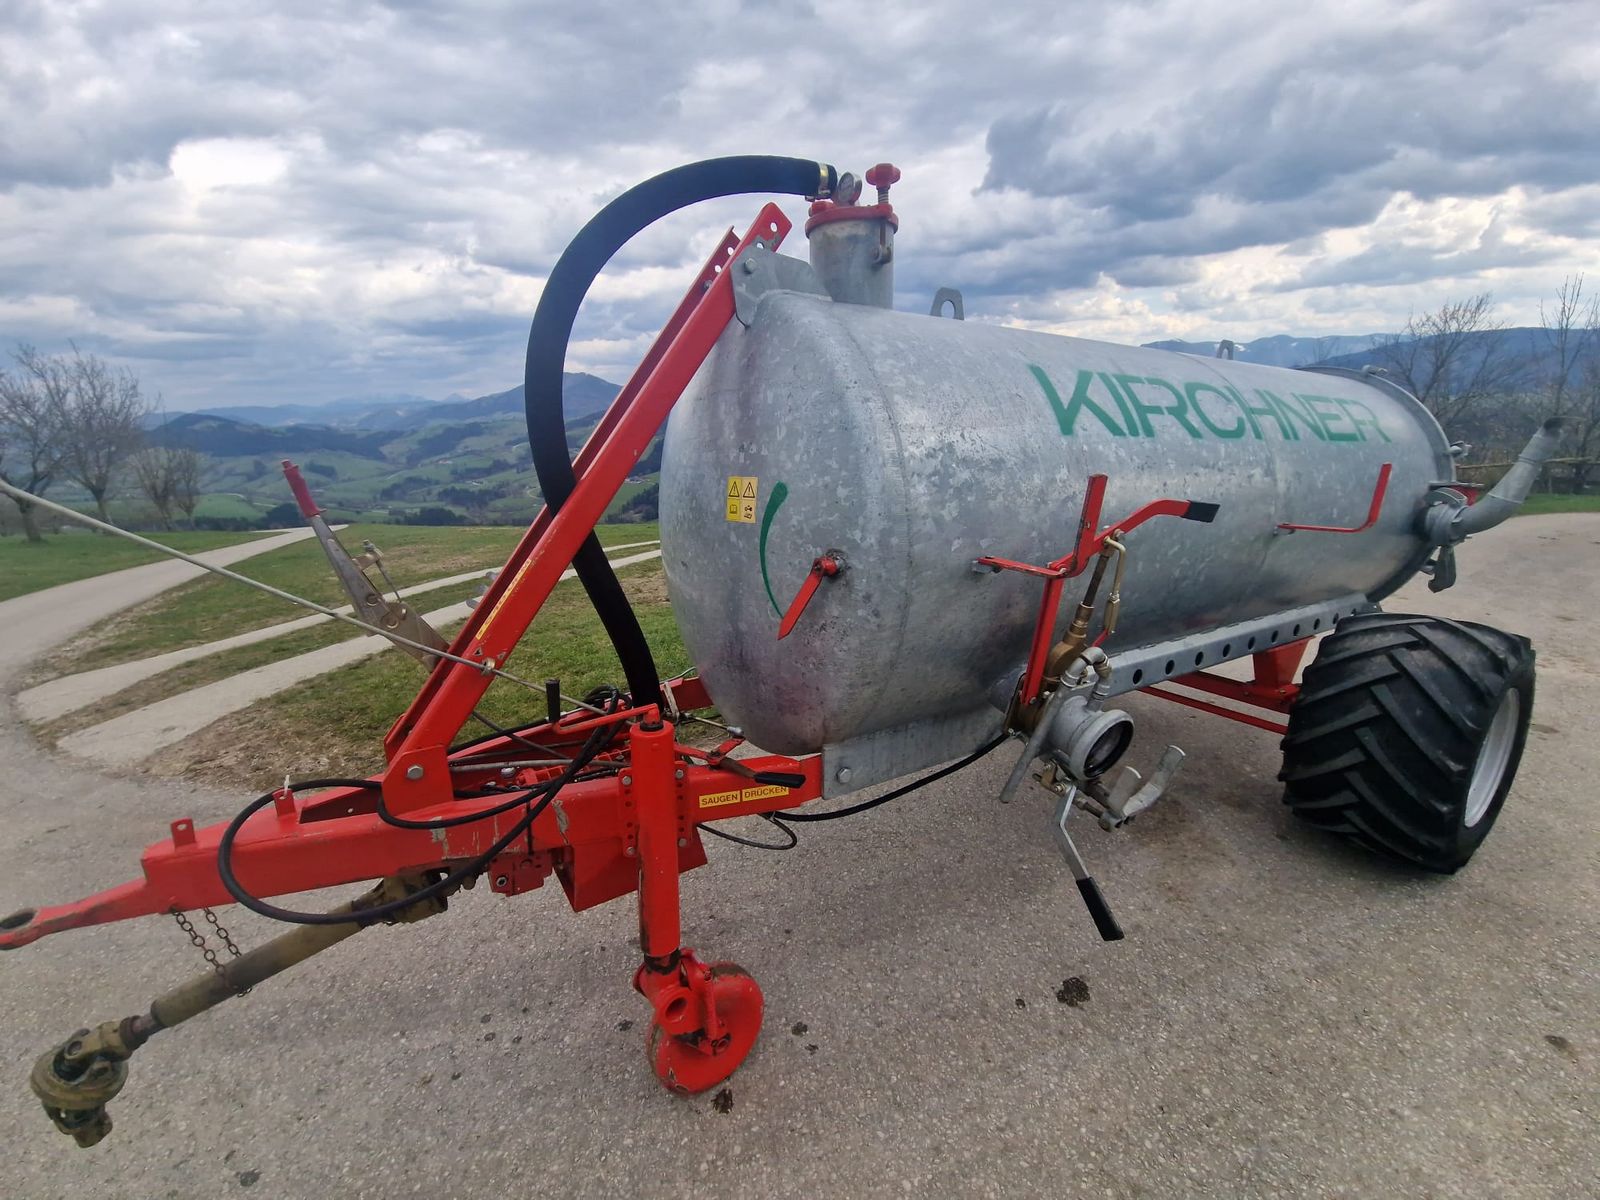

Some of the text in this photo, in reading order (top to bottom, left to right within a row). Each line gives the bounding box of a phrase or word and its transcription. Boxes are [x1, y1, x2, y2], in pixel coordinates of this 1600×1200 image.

[1027, 363, 1392, 443] KIRCHNER
[701, 786, 787, 806] SAUGEN DRÜCKEN
